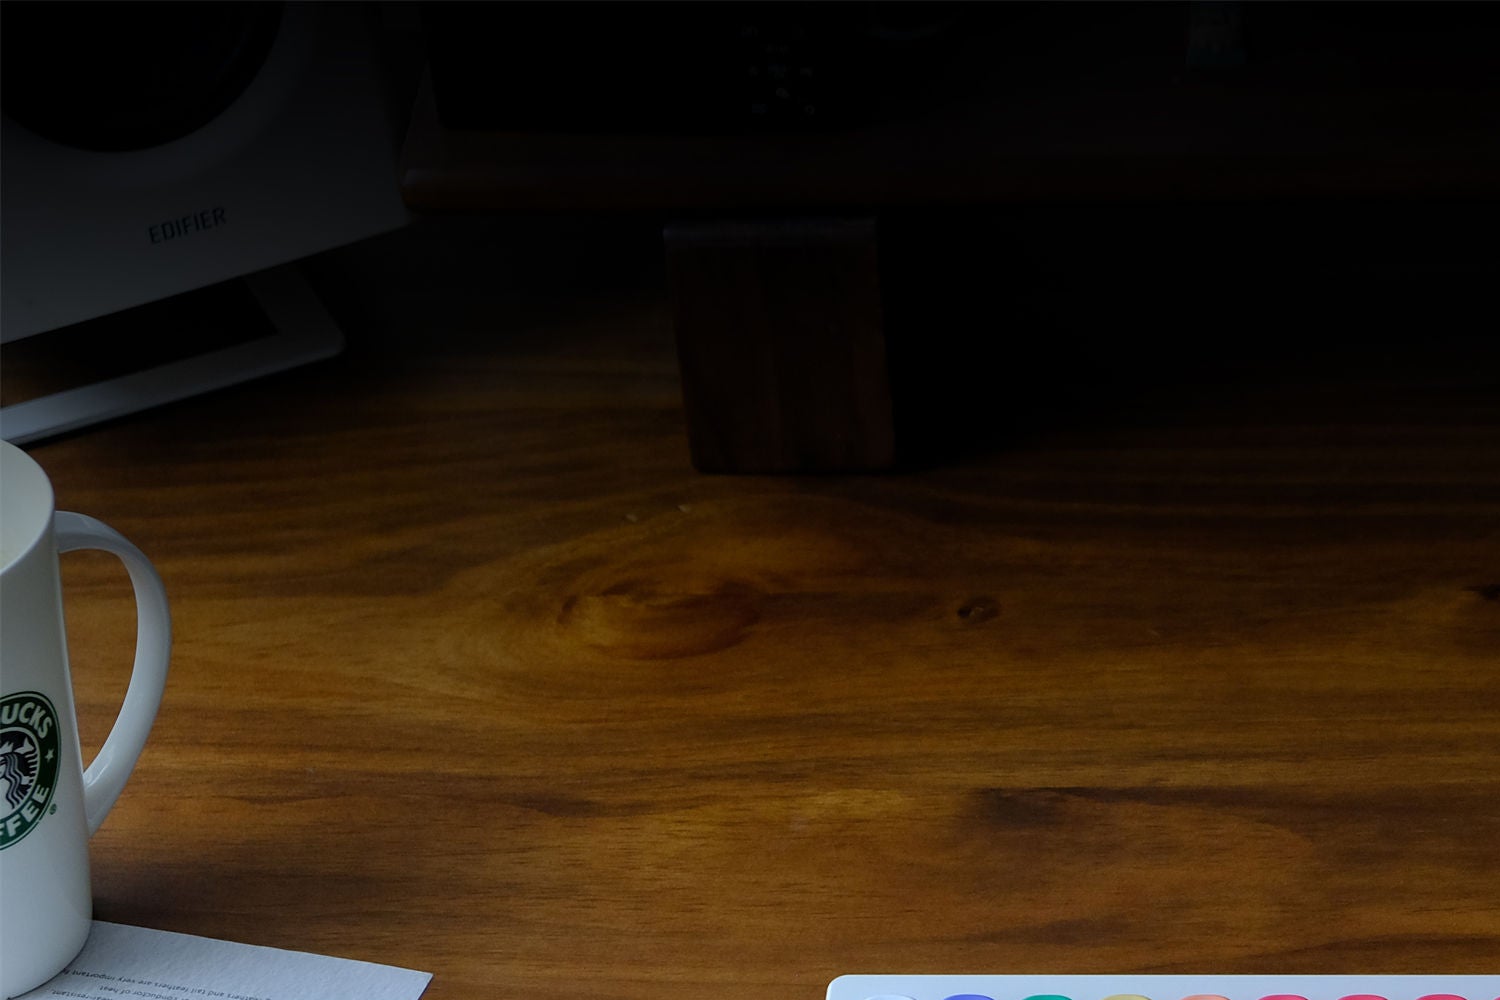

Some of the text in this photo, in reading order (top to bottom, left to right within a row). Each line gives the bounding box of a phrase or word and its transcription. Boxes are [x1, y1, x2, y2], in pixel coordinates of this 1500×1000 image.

[148, 206, 226, 244] EDIFIER
[72, 969, 116, 981] important
[118, 976, 136, 984] very
[154, 982, 189, 993] feathers
[133, 991, 178, 1000] conductor
